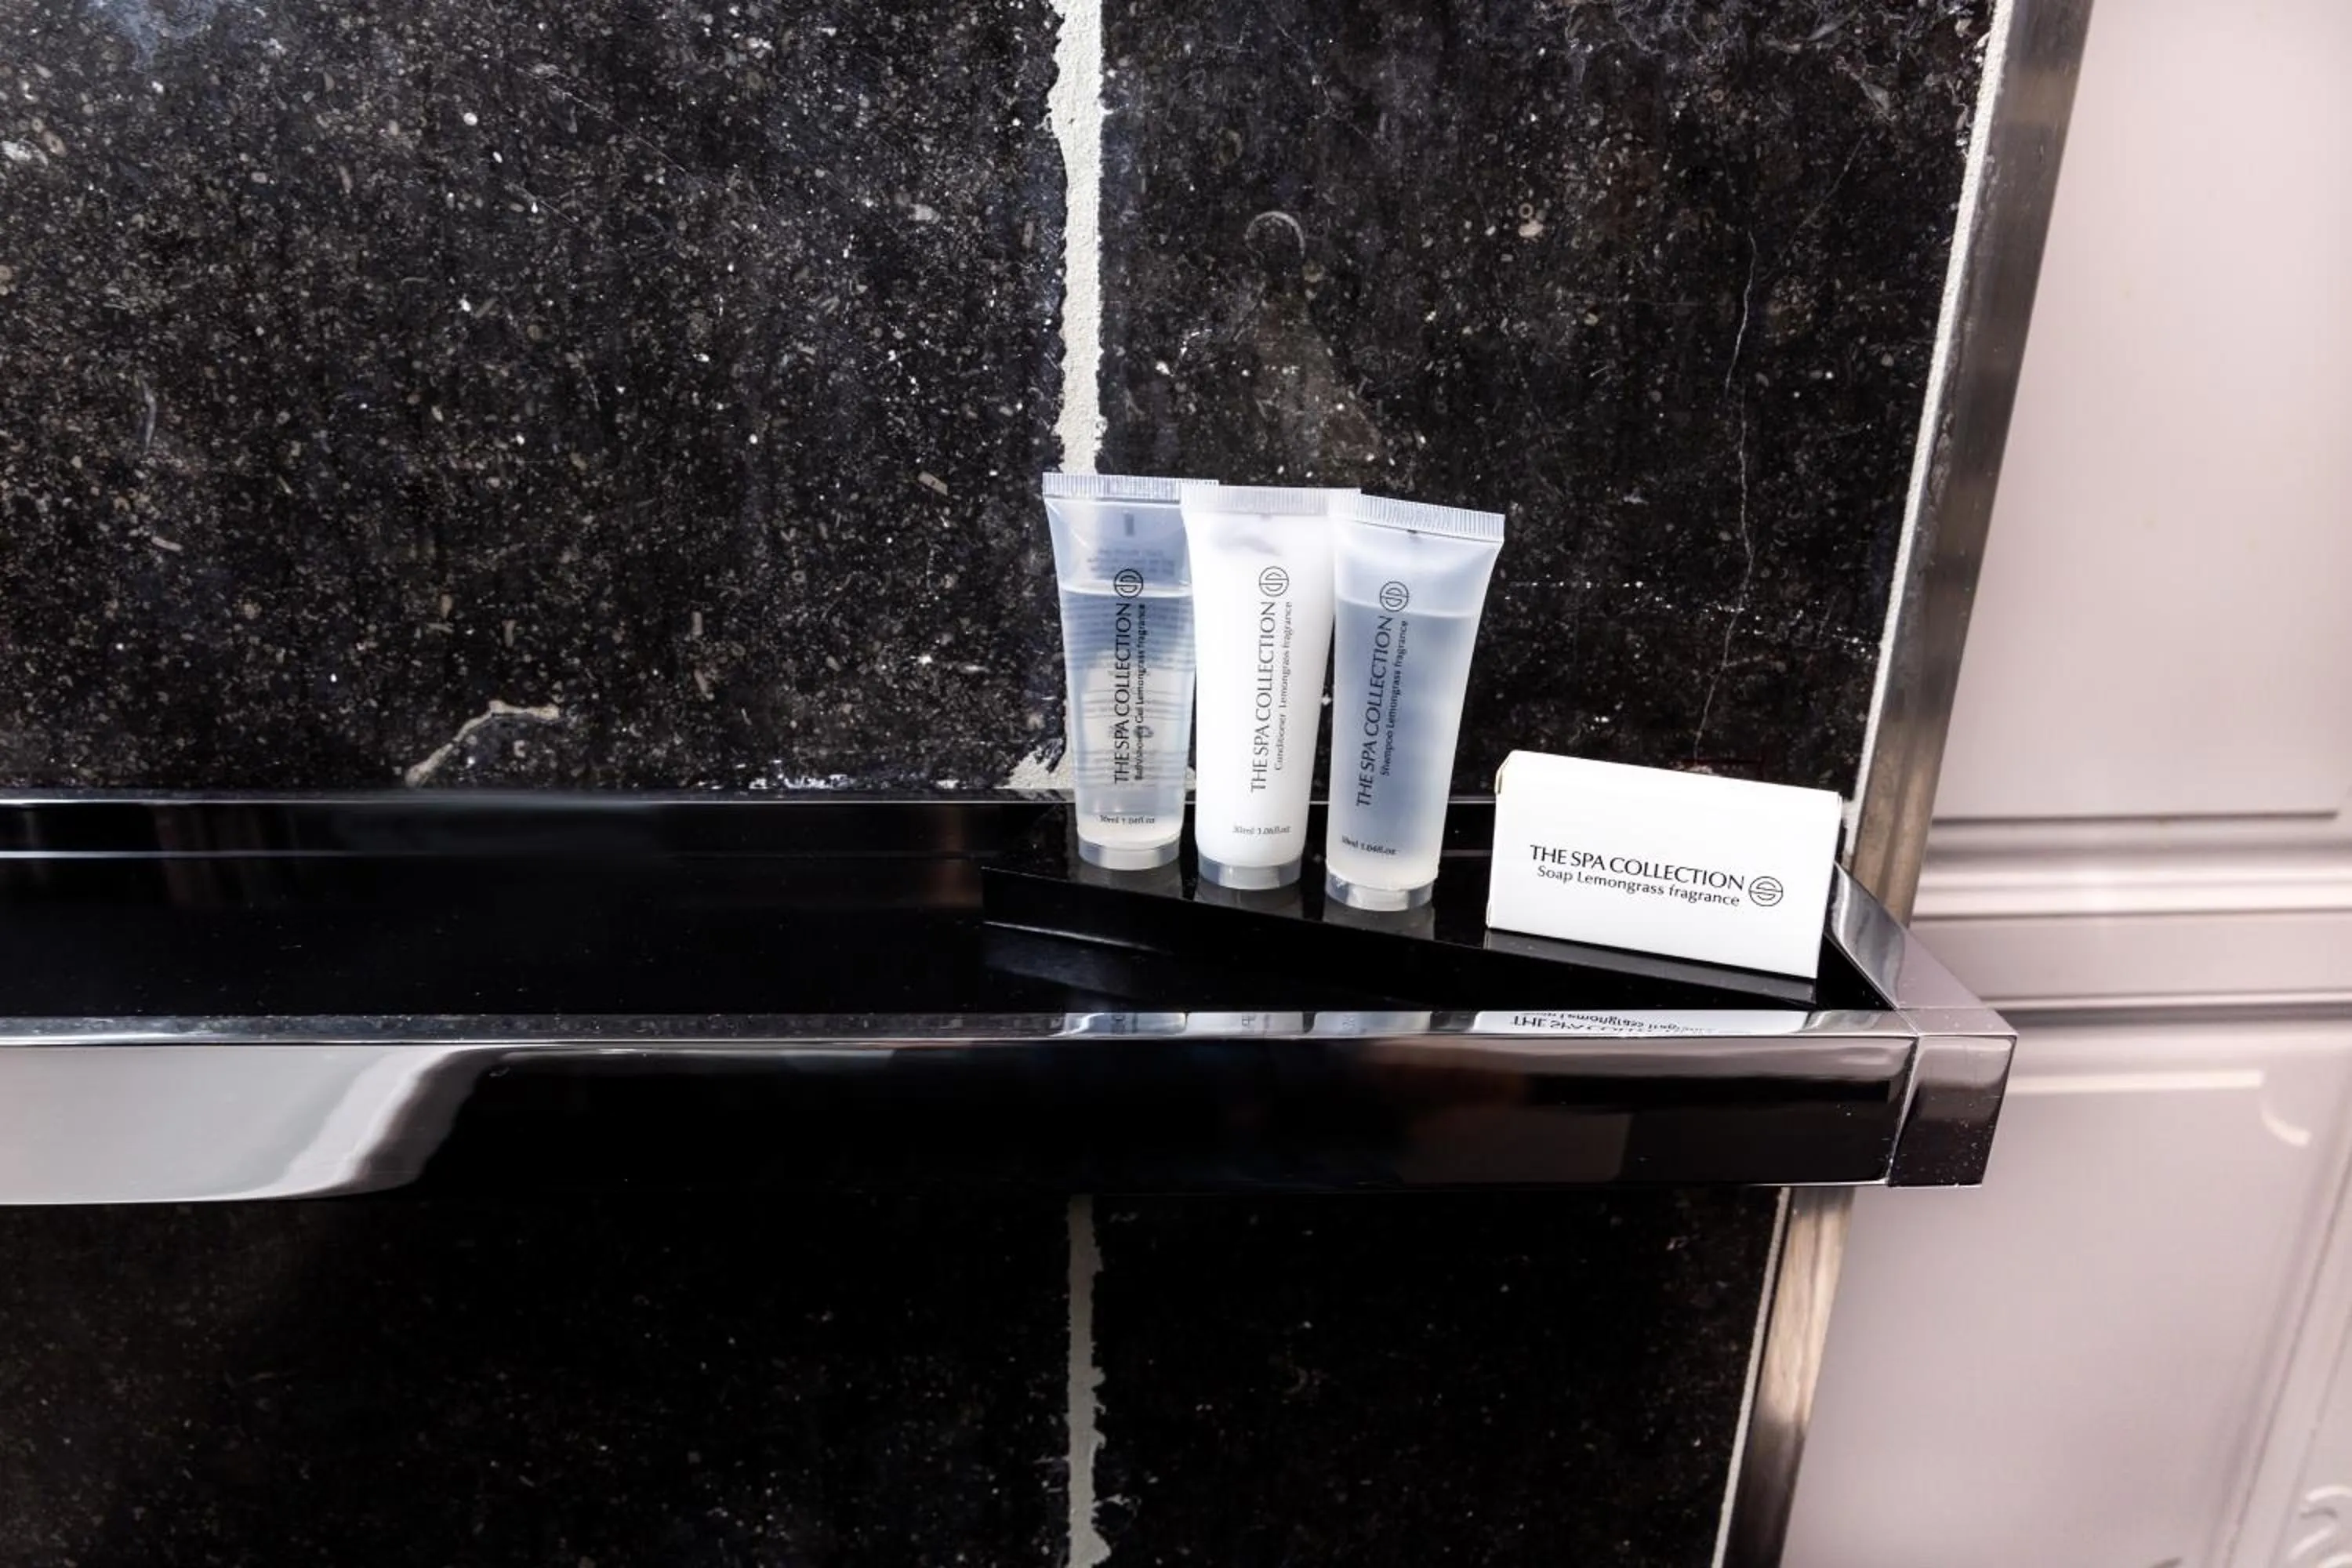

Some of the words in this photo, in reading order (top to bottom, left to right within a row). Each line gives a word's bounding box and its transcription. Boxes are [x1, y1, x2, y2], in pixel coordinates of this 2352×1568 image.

[1138, 604, 1149, 647] fragrance
[1283, 601, 1293, 648] fragrance
[1394, 619, 1409, 667] fragrance
[1114, 603, 1131, 717] COLLECTION
[1135, 648, 1147, 705] Lemongrass
[1255, 601, 1276, 721] COLLECTION
[1279, 651, 1291, 709] Lemongrass
[1364, 615, 1394, 737] COLLECTION
[1385, 670, 1401, 728] Lemongrass
[1114, 719, 1130, 751] SPA
[1253, 724, 1269, 757] SPA
[1274, 713, 1287, 771] Conditioner
[1360, 740, 1377, 773] SPA
[1380, 729, 1396, 776] Shampoo
[1114, 752, 1130, 784] THE
[1251, 759, 1268, 793] THE
[1356, 773, 1373, 807] THE
[1530, 844, 1567, 865] THE
[1570, 851, 1606, 871] SPA
[1610, 857, 1745, 891] COLLECTION
[1537, 865, 1573, 884] Soap
[1577, 871, 1664, 895] Lemongrass
[1668, 884, 1740, 906] fragrance
